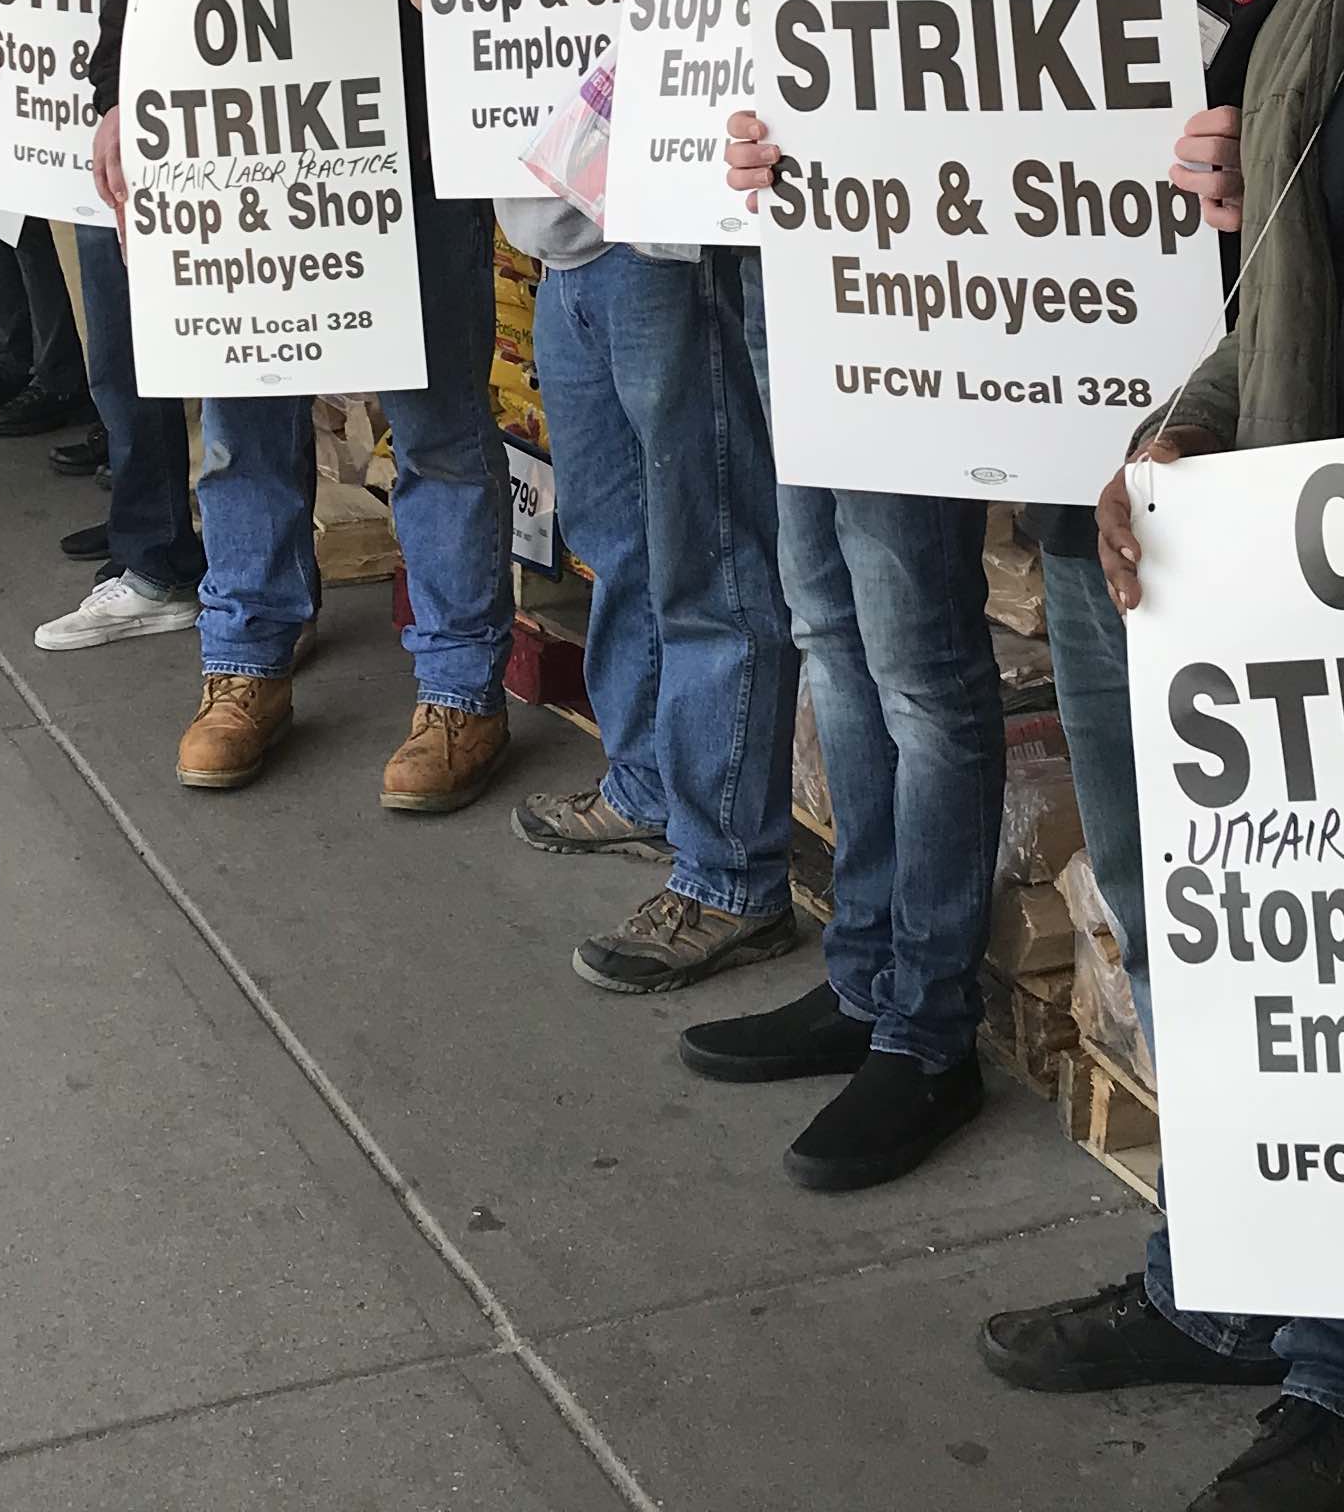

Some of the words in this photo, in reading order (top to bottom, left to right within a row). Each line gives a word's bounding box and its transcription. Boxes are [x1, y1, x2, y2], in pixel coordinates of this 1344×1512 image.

[660, 49, 756, 106] Emplo
[16, 86, 98, 130] Emplo
[135, 76, 386, 161] STRIKE
[472, 106, 539, 128] UFCW
[14, 145, 65, 167] UFCW
[143, 161, 221, 194] UNFAIR
[225, 156, 286, 188] LABOR
[289, 148, 397, 188] PRACTICE
[650, 138, 716, 163] UFCW
[134, 187, 221, 244] Stop
[238, 186, 271, 233] &
[288, 183, 402, 234] Shop
[770, 155, 910, 249] Stop
[937, 161, 988, 235] &
[1013, 160, 1202, 254] Shop
[173, 248, 364, 293] Employees
[832, 256, 1137, 334] Employees
[175, 317, 242, 336] UFCW
[252, 314, 317, 334] Local
[328, 311, 372, 330] 328
[224, 343, 322, 364] AFL-CIO
[836, 365, 941, 398] UFCW
[957, 372, 1062, 404] Local
[1078, 377, 1152, 407] 328
